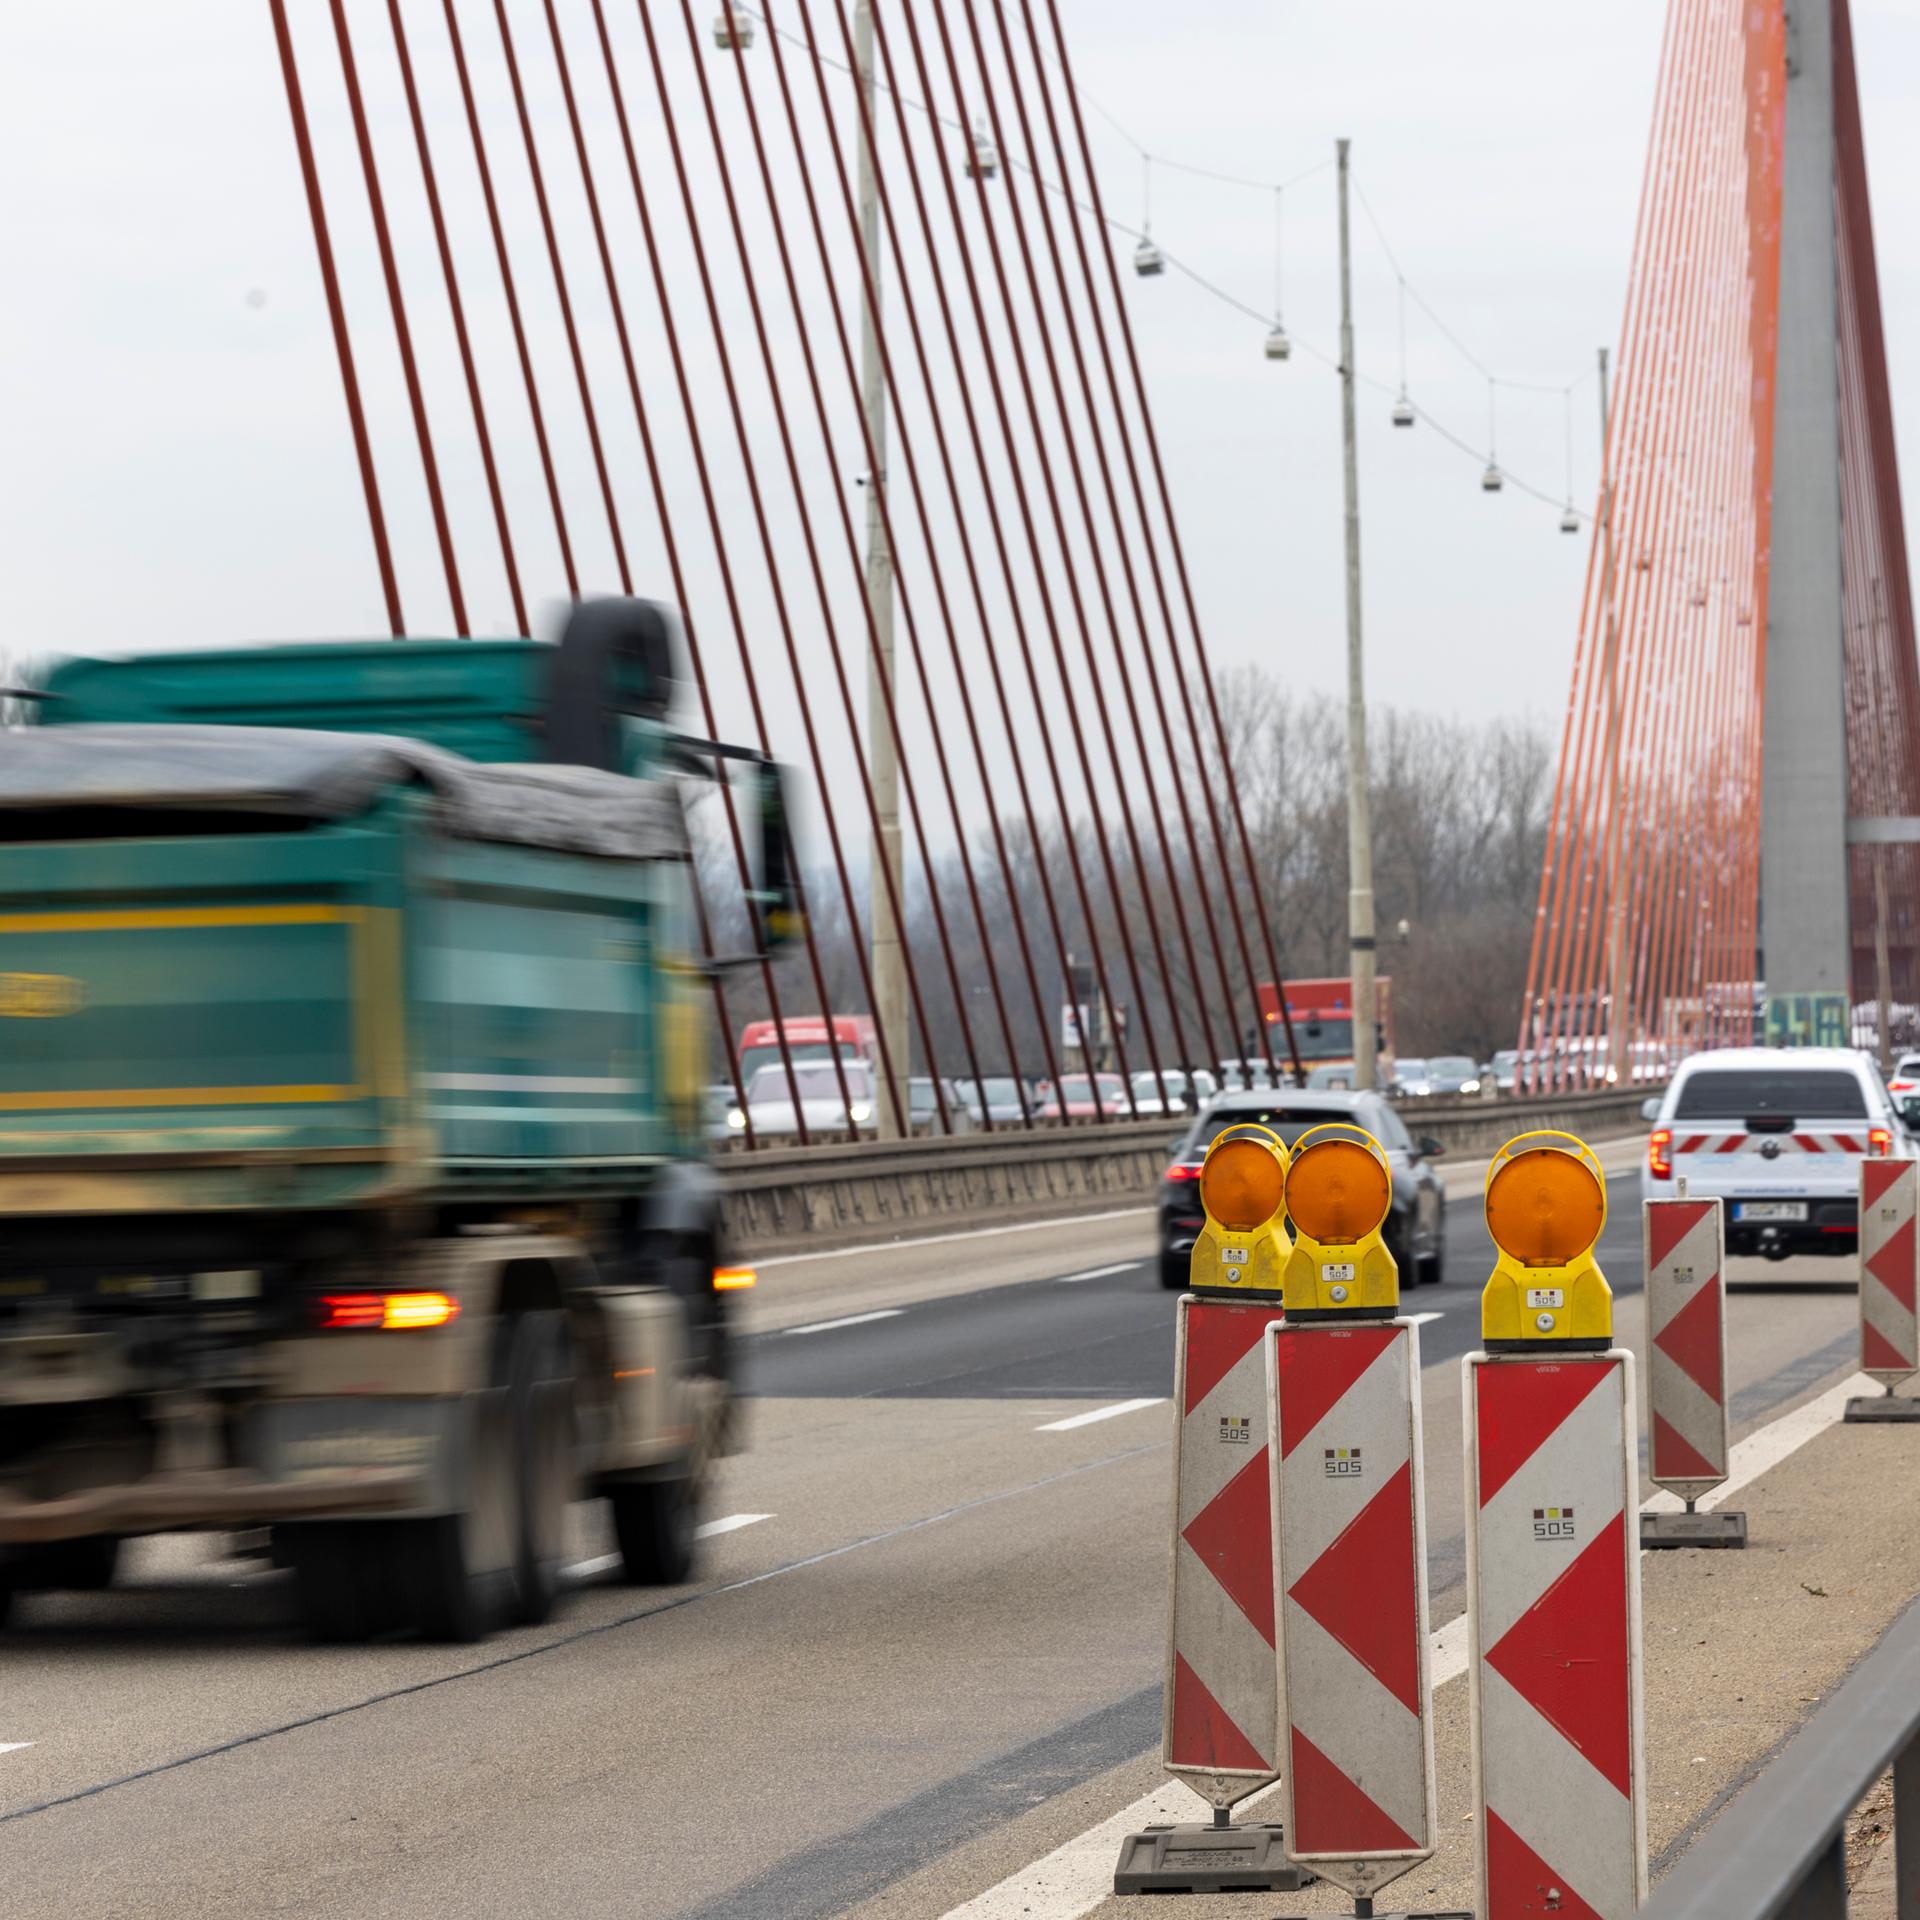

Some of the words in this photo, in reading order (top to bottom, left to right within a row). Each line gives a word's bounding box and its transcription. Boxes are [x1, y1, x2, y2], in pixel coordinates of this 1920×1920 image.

[1329, 1271, 1348, 1279] SOS
[1535, 1297, 1556, 1305] SOS
[1220, 1428, 1249, 1440] SOS
[1325, 1461, 1362, 1474] SOS
[1534, 1522, 1574, 1536] SOS
